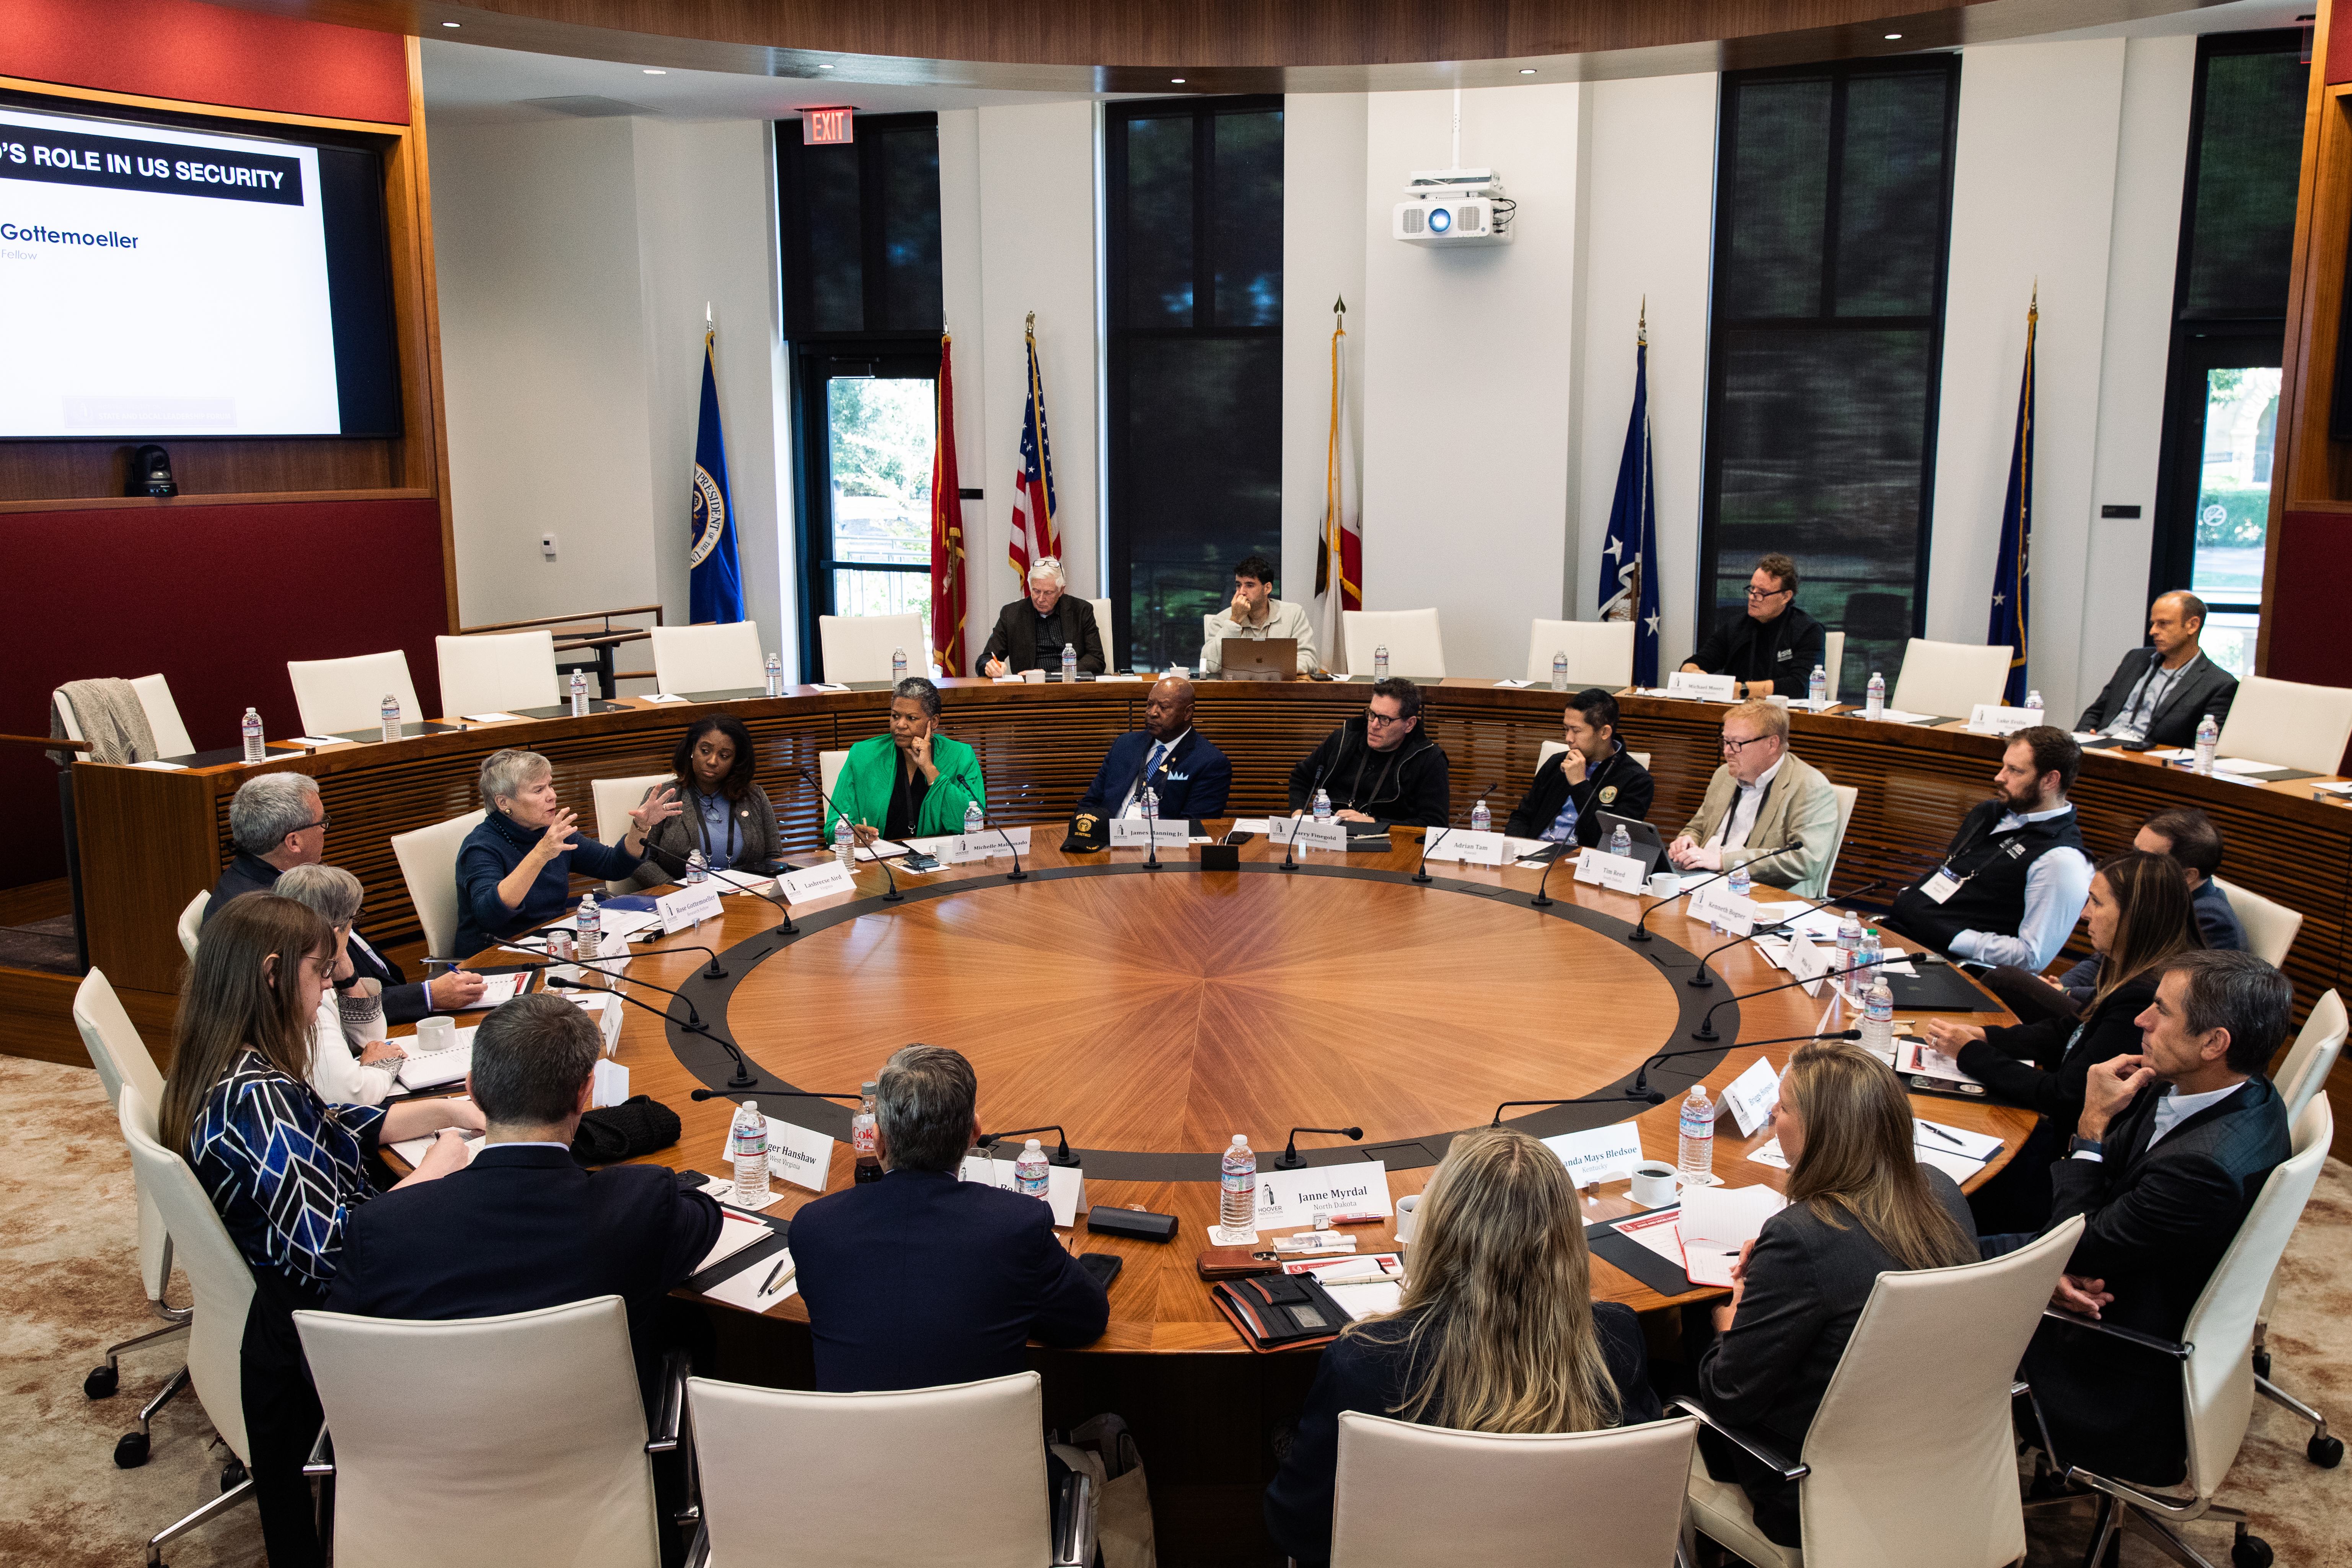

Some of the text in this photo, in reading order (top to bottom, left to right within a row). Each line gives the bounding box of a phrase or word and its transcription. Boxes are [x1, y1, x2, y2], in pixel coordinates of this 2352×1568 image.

[812, 112, 844, 141] EXIT
[0, 142, 284, 189] 'S ROLE IN US SECURITY
[0, 223, 138, 248] Gottemoeller
[2, 249, 37, 260] Fellow
[697, 472, 721, 531] PRESIDENT
[701, 541, 710, 552] THE
[804, 878, 830, 888] Lashrecse
[687, 895, 715, 910] Gottemoeller
[853, 1127, 873, 1139] Cok
[768, 1144, 781, 1152] ger
[782, 1146, 816, 1164] Hanshaw
[1563, 1147, 1637, 1167] anda Mays Bledsoe
[770, 1155, 800, 1170] West Virginia
[1582, 1164, 1607, 1173] Kentucky
[1298, 1186, 1368, 1204] Janne Myrdal
